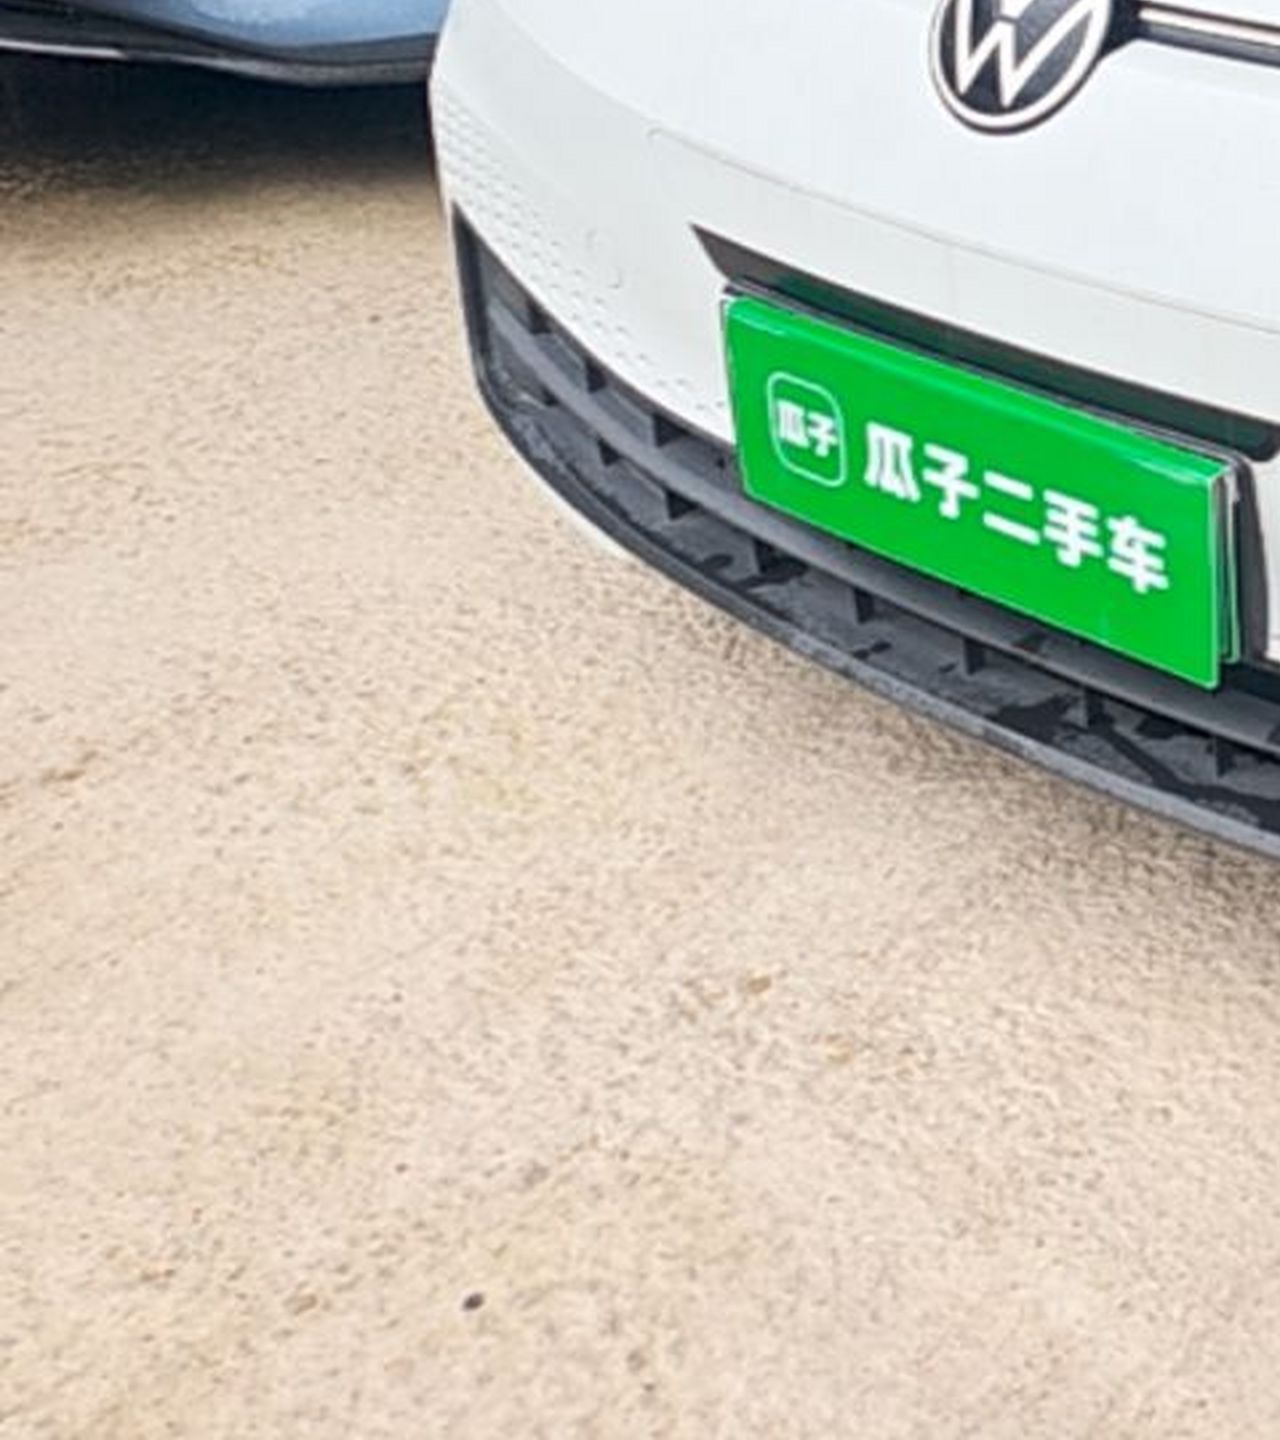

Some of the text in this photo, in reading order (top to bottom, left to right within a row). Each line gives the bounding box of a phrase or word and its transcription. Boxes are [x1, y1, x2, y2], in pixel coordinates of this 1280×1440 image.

[775, 398, 839, 458] 瓜子
[863, 420, 1170, 594] 瓜子二手车
